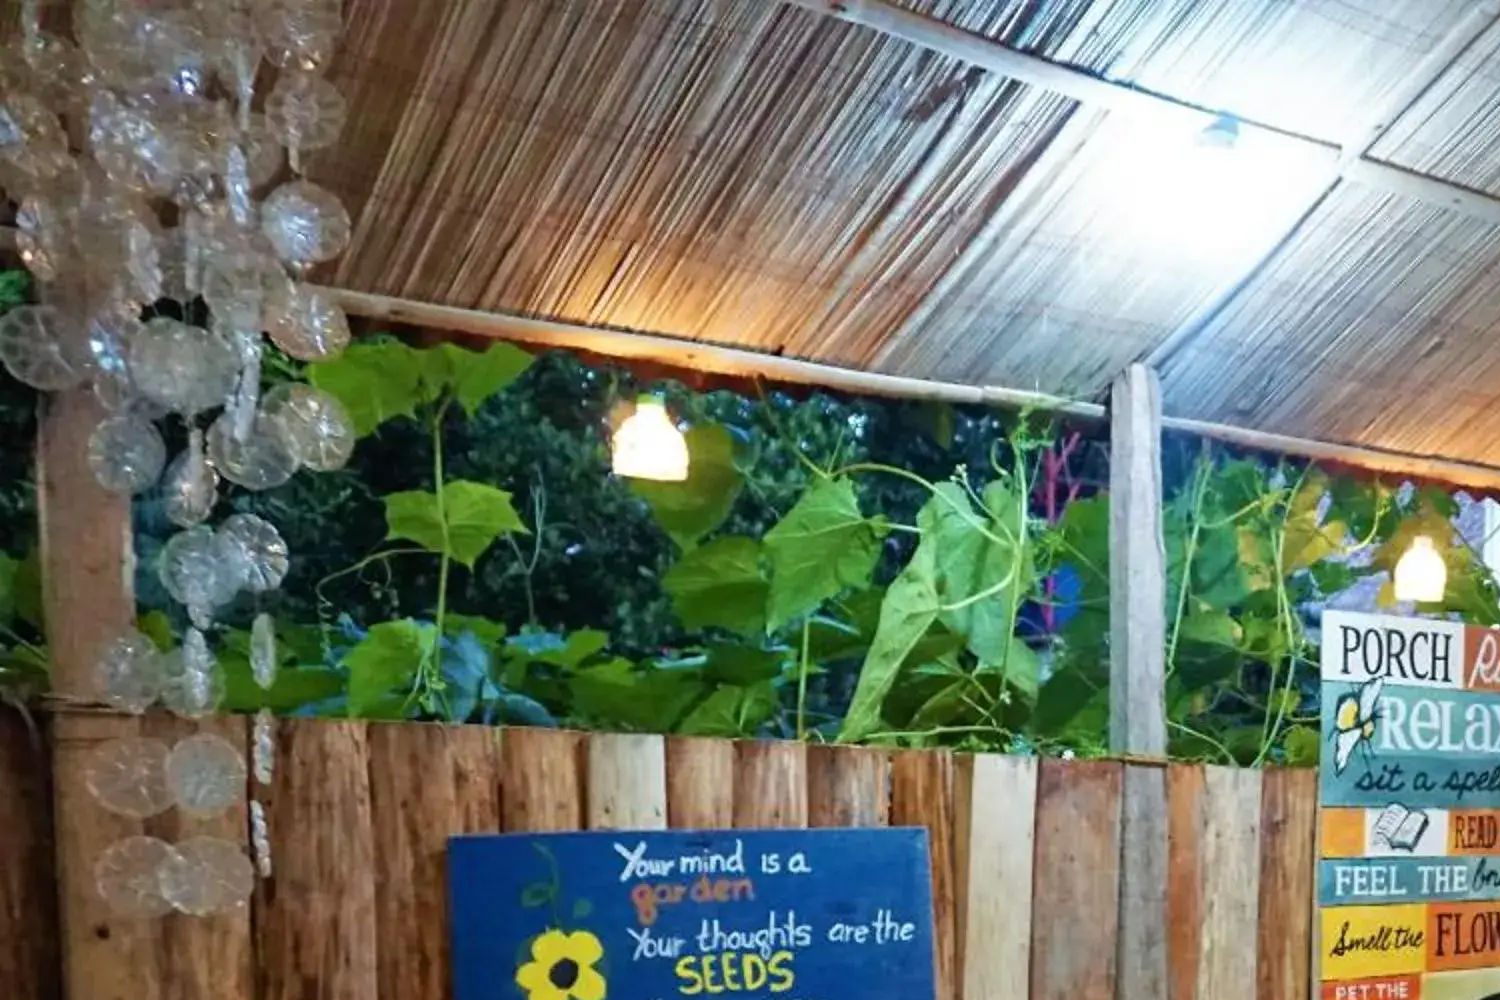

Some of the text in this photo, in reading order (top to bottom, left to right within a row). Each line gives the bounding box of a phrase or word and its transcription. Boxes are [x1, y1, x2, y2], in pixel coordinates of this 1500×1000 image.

[1340, 625, 1452, 683] PORCH
[1355, 763, 1406, 791] sit
[1412, 770, 1436, 790] a
[1454, 815, 1496, 850] READ
[615, 838, 812, 882] Your mind is a
[631, 876, 755, 925] garden
[1334, 865, 1407, 896] FEEL
[1417, 865, 1468, 894] THE
[626, 909, 915, 961] Your thoughts are the
[1329, 921, 1390, 957] Smell
[674, 950, 796, 995] SEEDS
[1375, 981, 1409, 1000] THE
